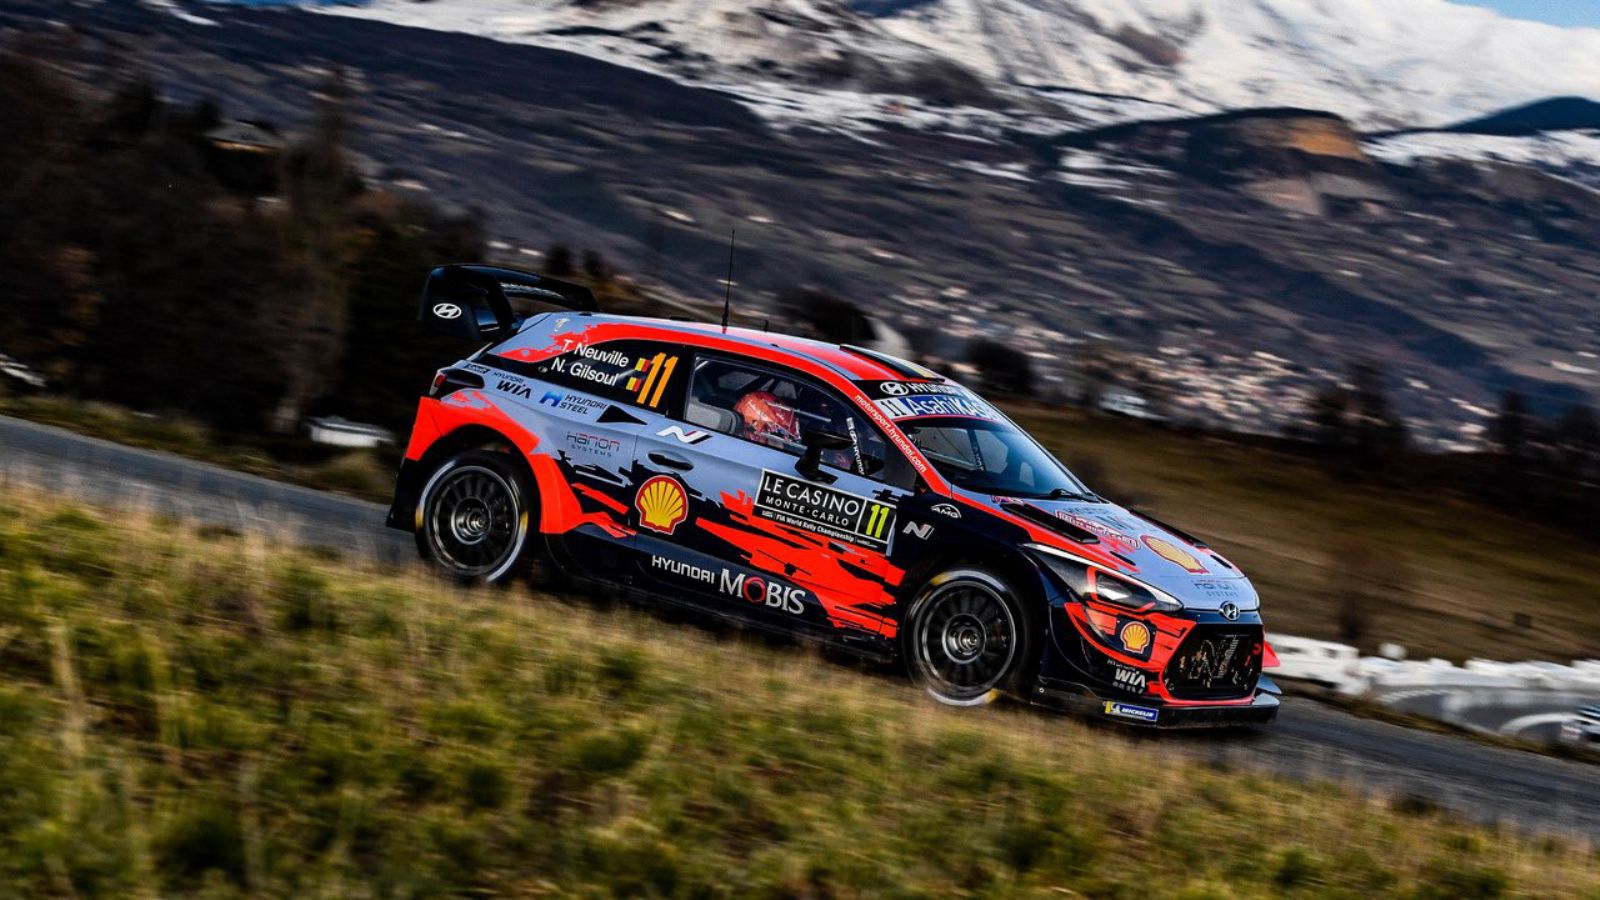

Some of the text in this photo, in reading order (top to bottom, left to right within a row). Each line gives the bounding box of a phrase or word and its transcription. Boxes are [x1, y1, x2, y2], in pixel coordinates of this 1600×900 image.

[562, 340, 629, 367] T. Neuville
[551, 357, 620, 386] N. Gilsoul
[636, 352, 678, 408] 11
[496, 380, 532, 399] WIA
[564, 394, 607, 410] HYUNDAI
[559, 403, 588, 415] STEEL
[855, 394, 926, 473] motorsport.hyundai.com
[763, 475, 859, 516] LE CASINO
[786, 516, 802, 527] World
[802, 520, 817, 532] Rally
[817, 524, 855, 543] Championship
[865, 504, 890, 538] 11
[651, 555, 807, 615] HYUNDAI MOBIS
